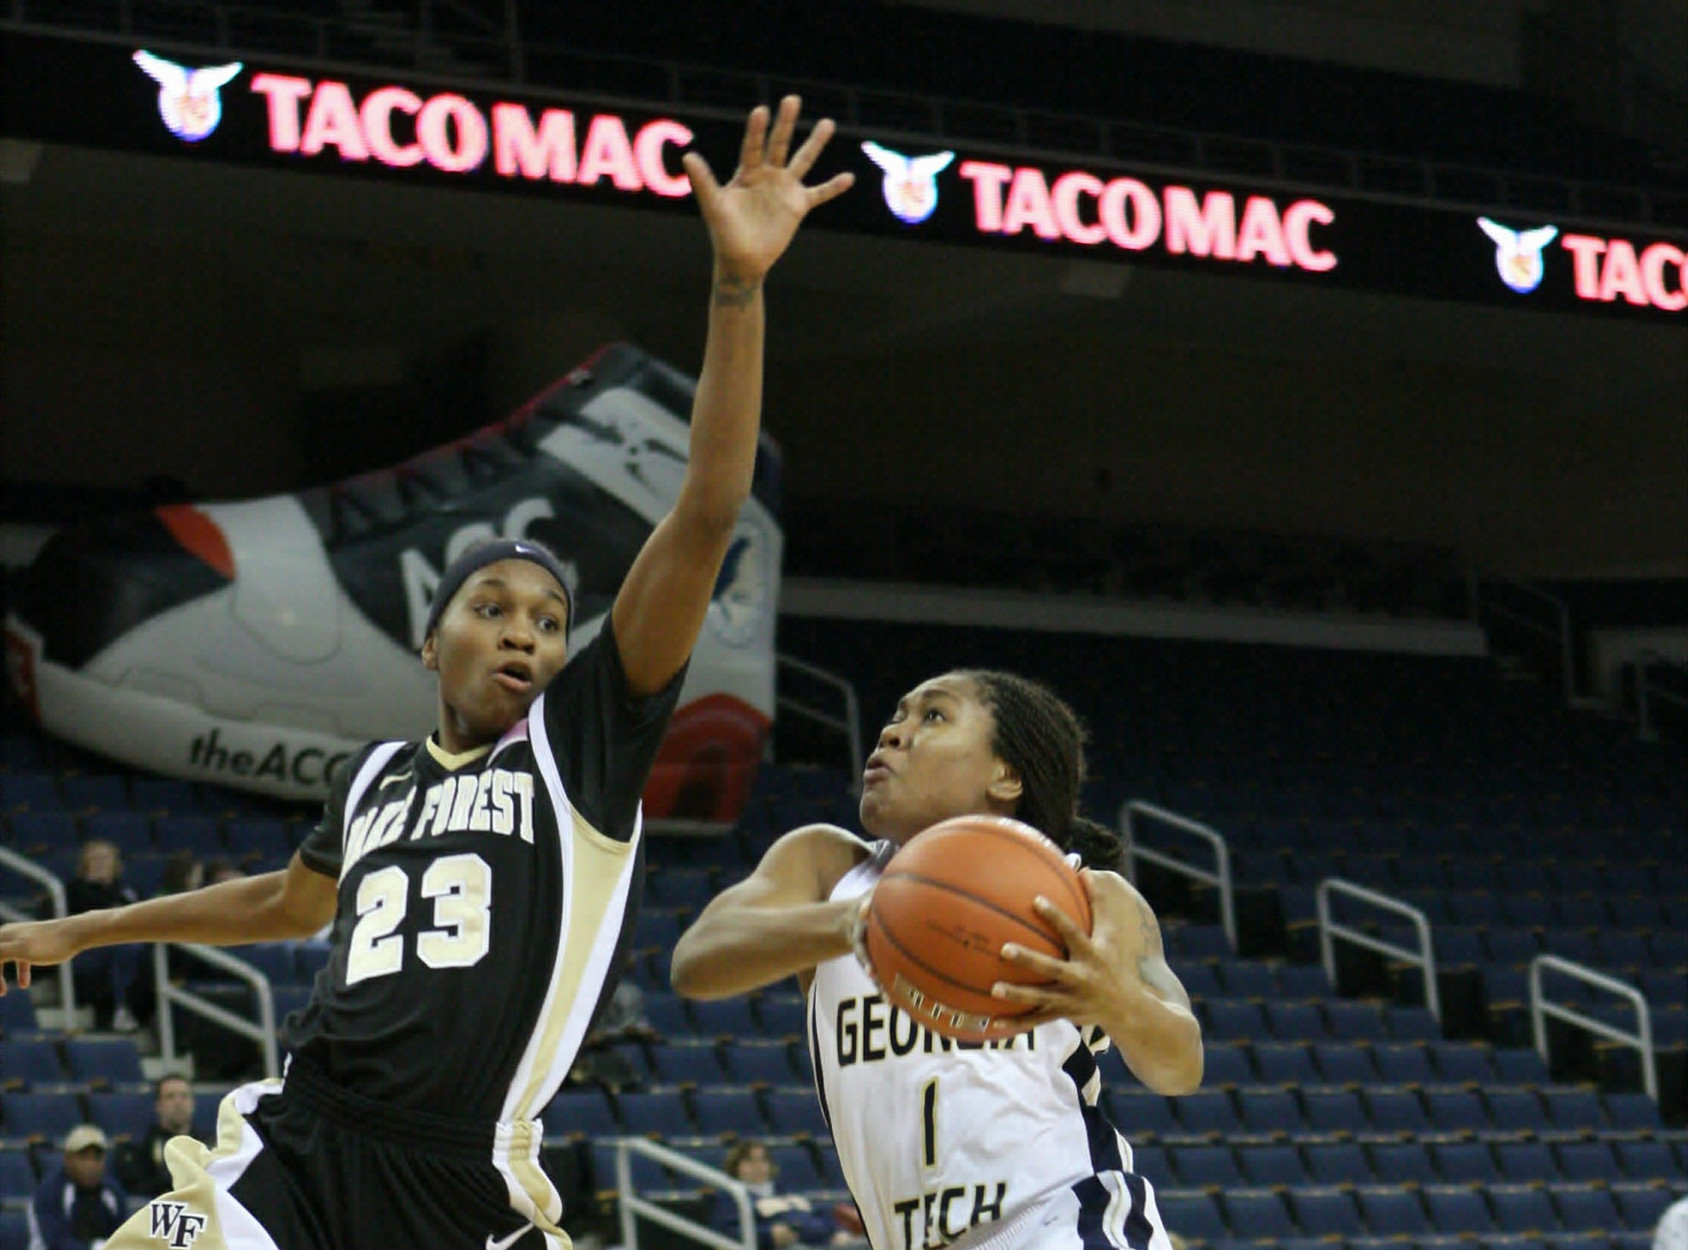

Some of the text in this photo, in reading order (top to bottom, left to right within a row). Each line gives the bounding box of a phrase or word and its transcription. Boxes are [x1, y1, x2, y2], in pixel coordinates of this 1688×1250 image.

[251, 74, 695, 198] TACO MAC
[960, 160, 1338, 273] TACO MAC
[1562, 234, 1688, 311] TAC
[411, 769, 534, 844] FOREST
[346, 853, 492, 986] 23
[921, 1076, 939, 1169] 1
[149, 1201, 208, 1250] WF
